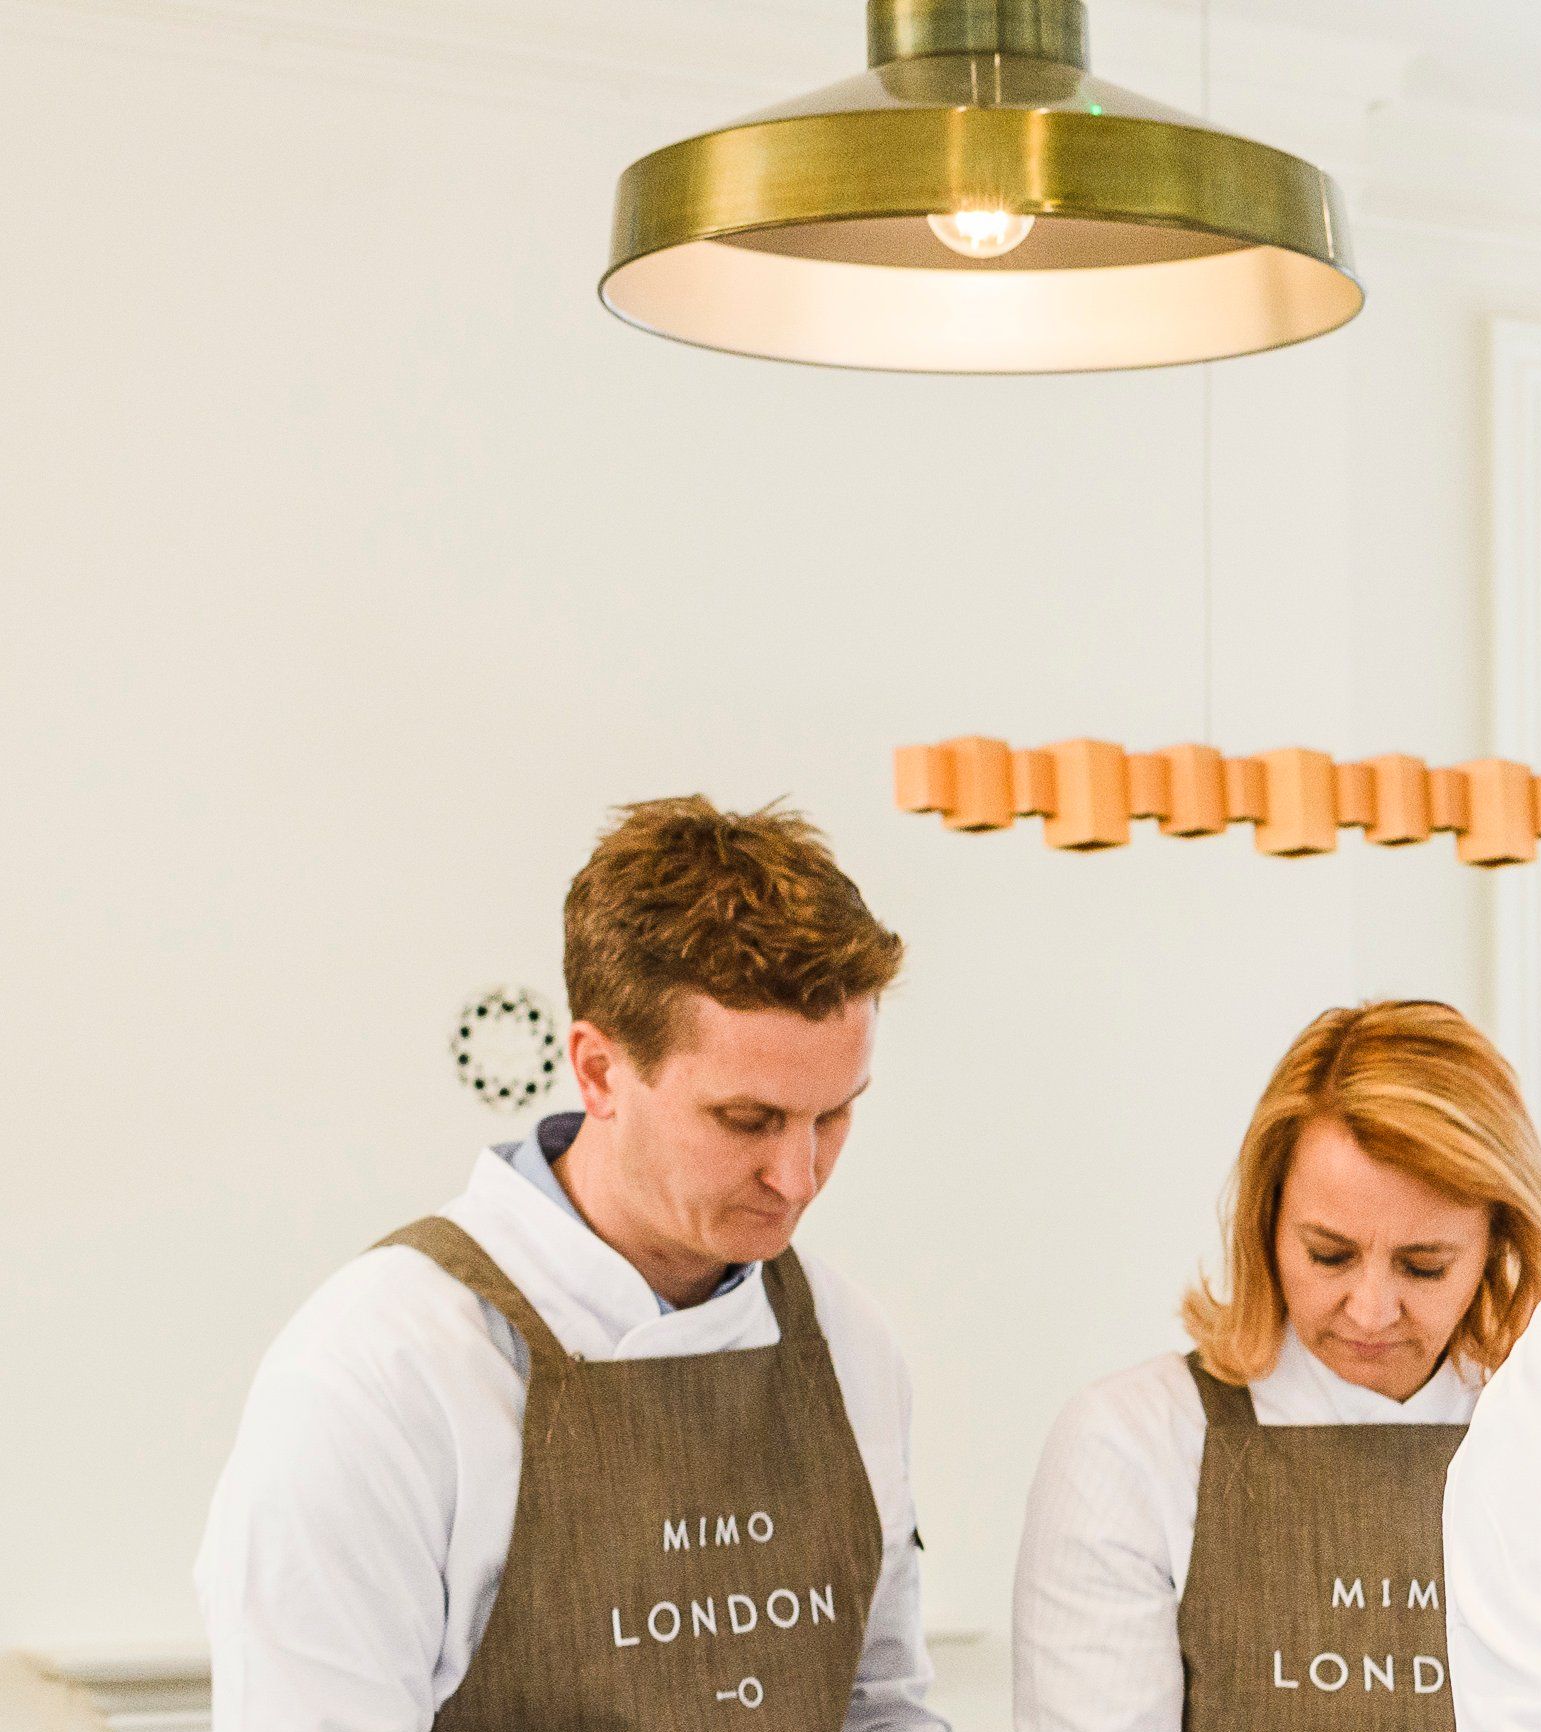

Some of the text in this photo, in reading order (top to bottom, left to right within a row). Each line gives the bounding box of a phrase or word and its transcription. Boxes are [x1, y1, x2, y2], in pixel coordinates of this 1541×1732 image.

[663, 1511, 774, 1552] MIMO
[1332, 1577, 1439, 1610] MIM
[611, 1584, 835, 1648] LONDON
[1274, 1650, 1445, 1694] LOND
